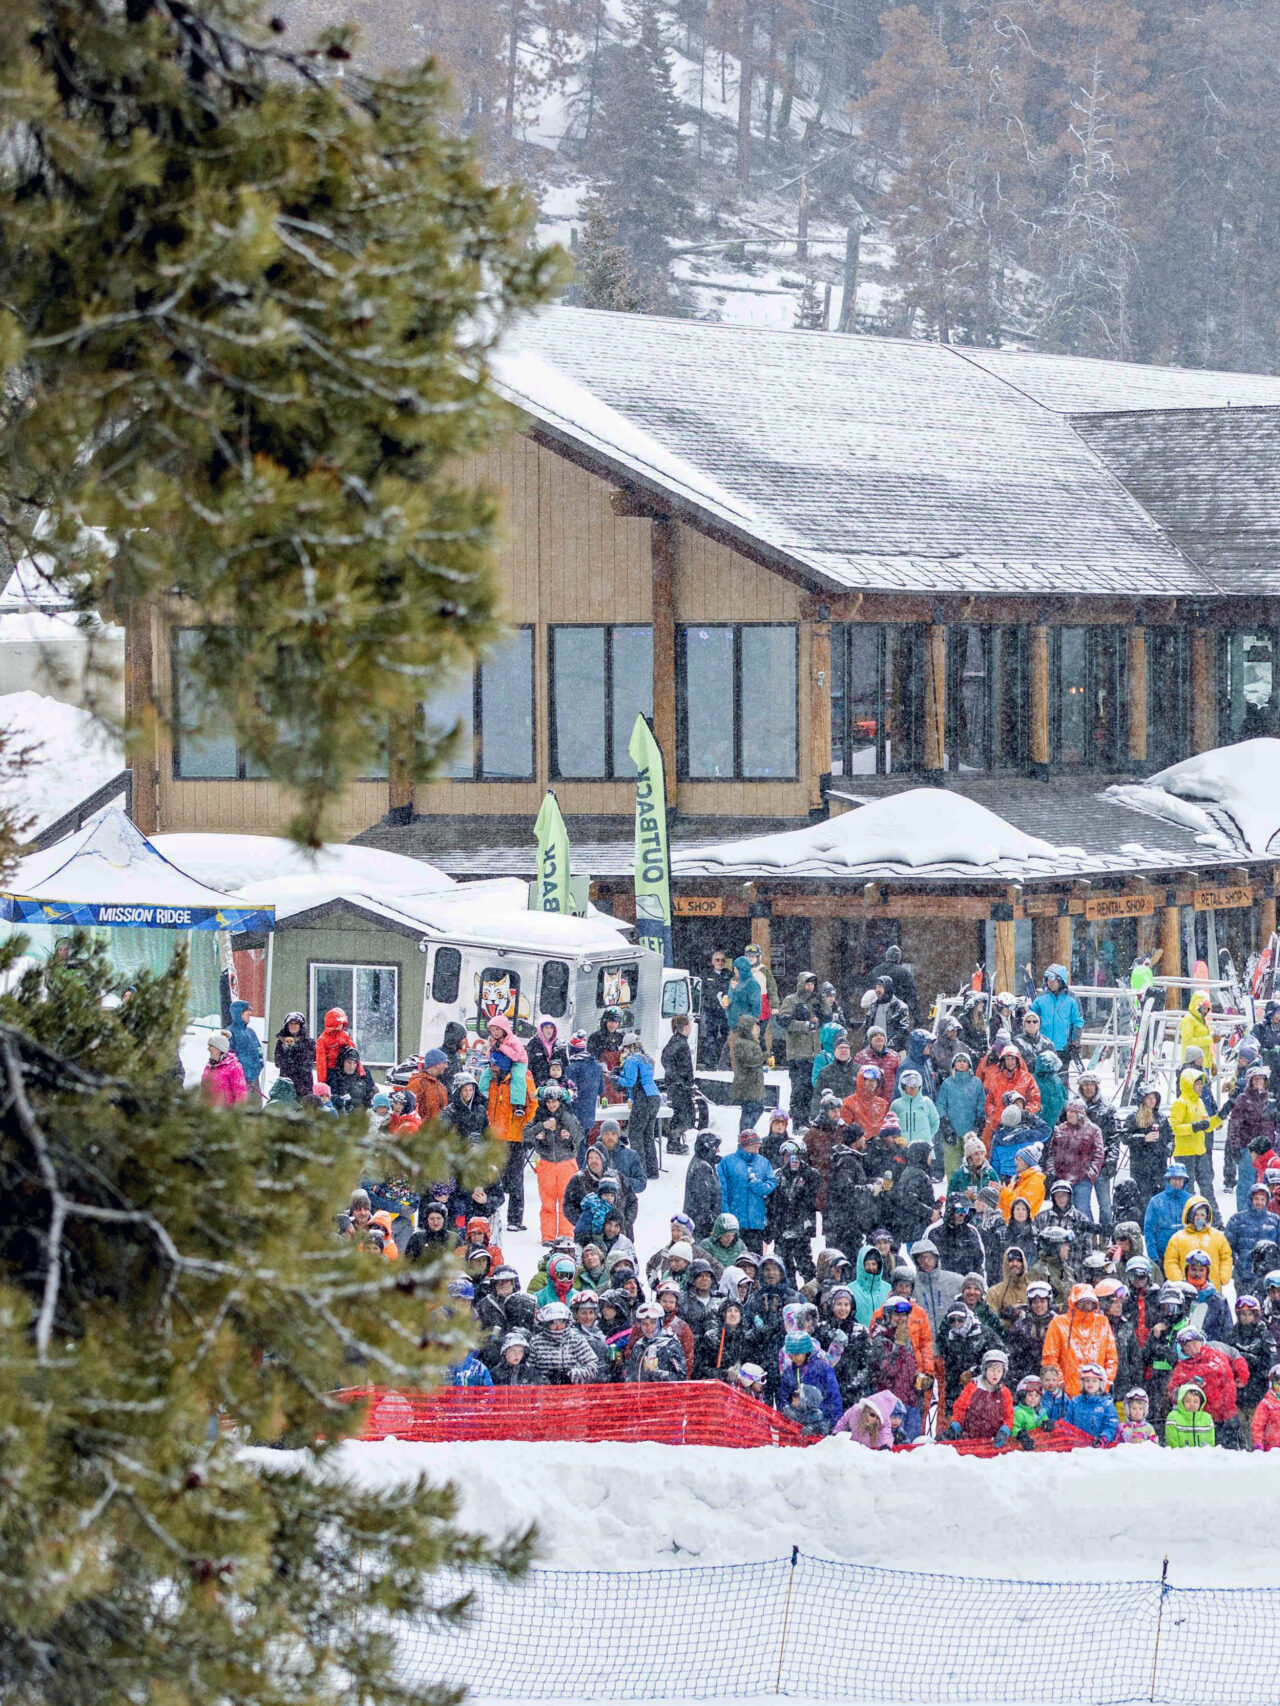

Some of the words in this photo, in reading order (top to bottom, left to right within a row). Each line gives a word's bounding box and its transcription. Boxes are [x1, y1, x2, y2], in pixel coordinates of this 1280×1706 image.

[1225, 889, 1243, 904] SHOP
[688, 901, 717, 912] SHOP
[1096, 901, 1124, 916] RENTAL
[1126, 899, 1145, 913] SHOP
[99, 907, 152, 923] MISSION
[156, 909, 192, 924] RIDGE
